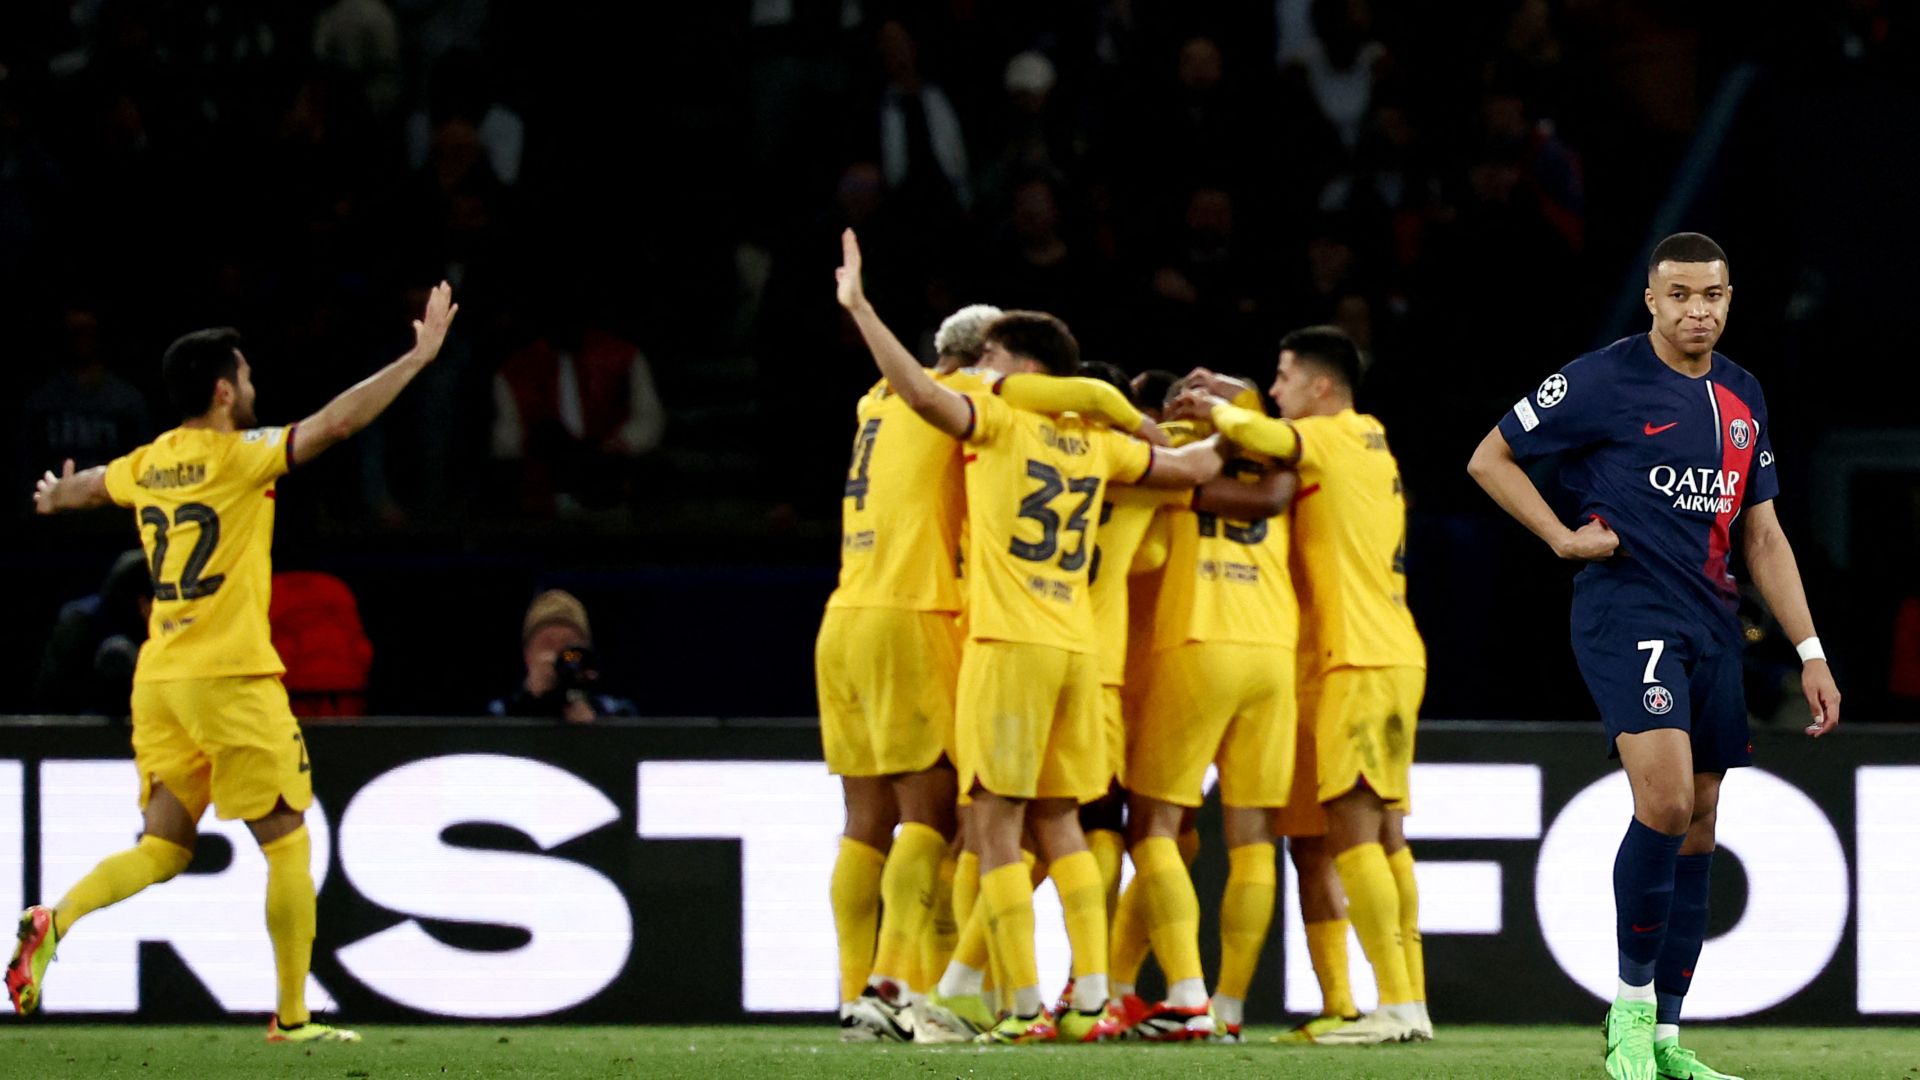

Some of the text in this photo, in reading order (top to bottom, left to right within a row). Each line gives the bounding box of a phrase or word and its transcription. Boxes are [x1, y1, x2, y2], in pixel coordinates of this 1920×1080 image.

[1649, 465, 1740, 498] QATAR
[1009, 459, 1100, 572] 33
[1672, 495, 1734, 514] AIRWAYS
[141, 502, 225, 601] 22
[1637, 640, 1664, 683] 7
